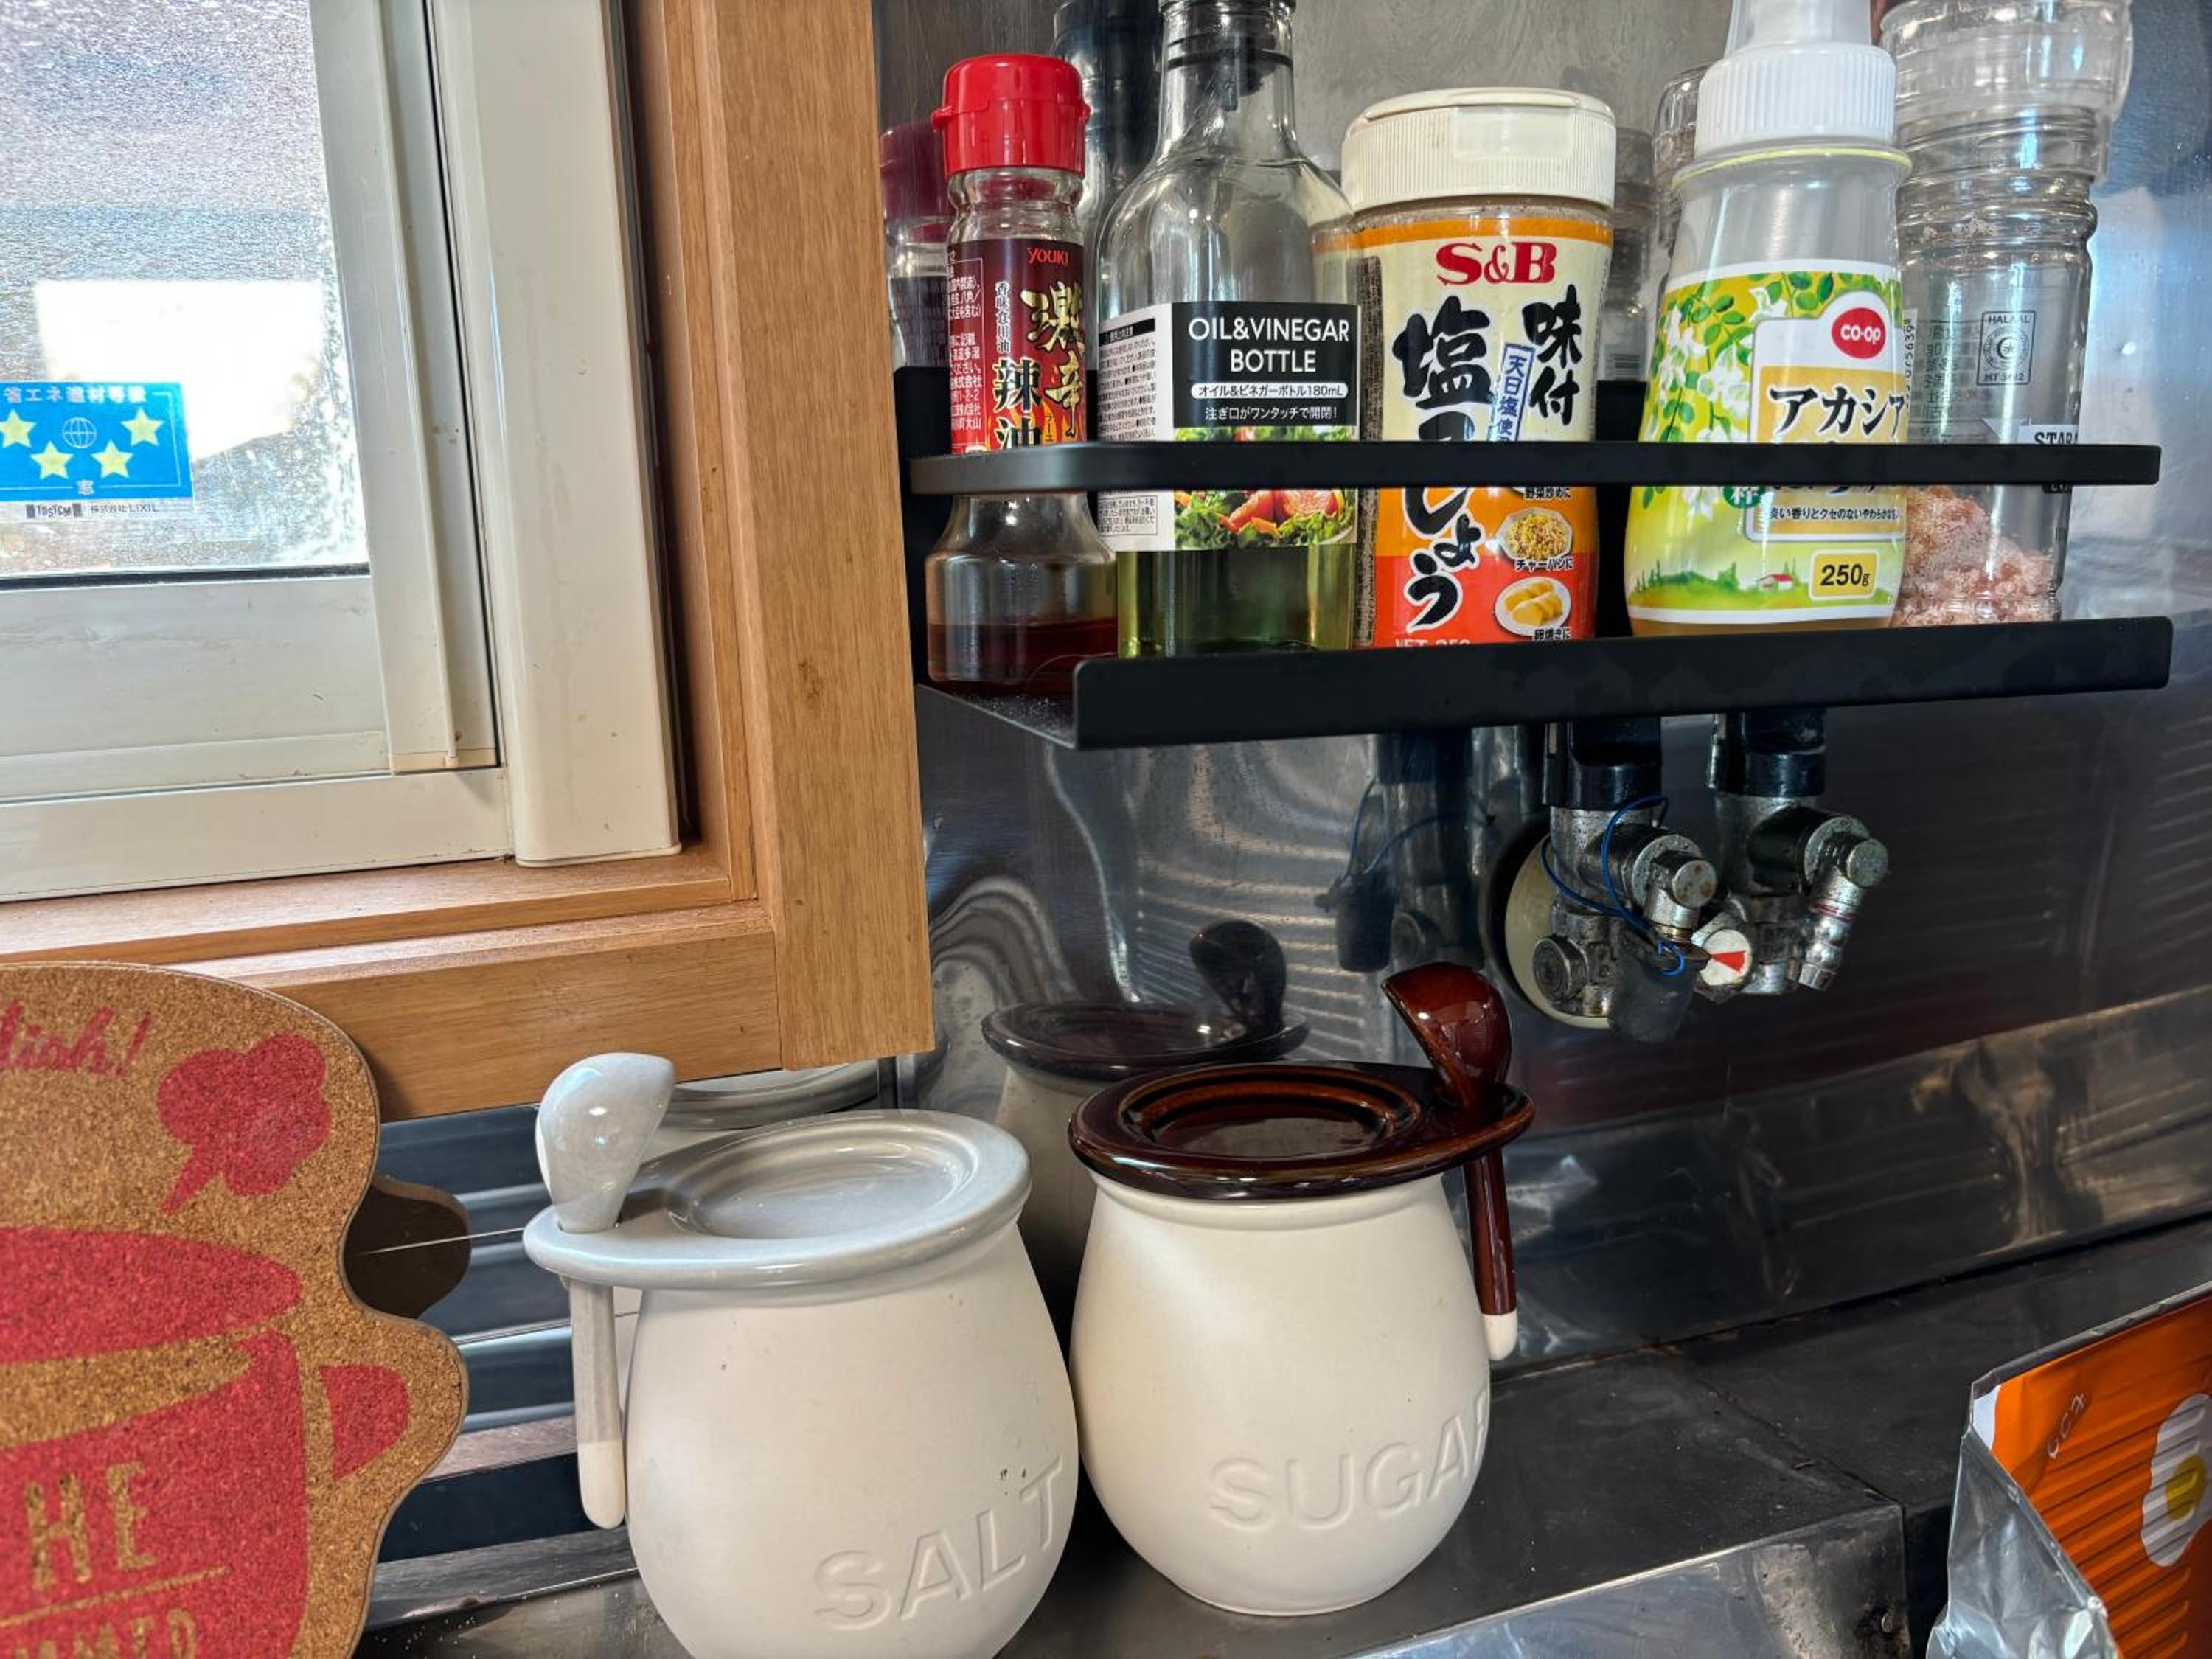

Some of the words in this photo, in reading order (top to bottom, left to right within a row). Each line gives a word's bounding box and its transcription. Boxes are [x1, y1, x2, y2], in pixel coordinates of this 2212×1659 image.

[1436, 241, 1557, 285] S&B
[1188, 316, 1350, 342] OIL&VINEGAR
[1231, 349, 1317, 373] BOTTLE
[1522, 283, 1582, 425] 味付
[1769, 386, 1905, 437] アカシア
[1515, 557, 1573, 571] チャーハンに
[1820, 563, 1871, 588] 250g
[813, 1455, 1064, 1632] SALT
